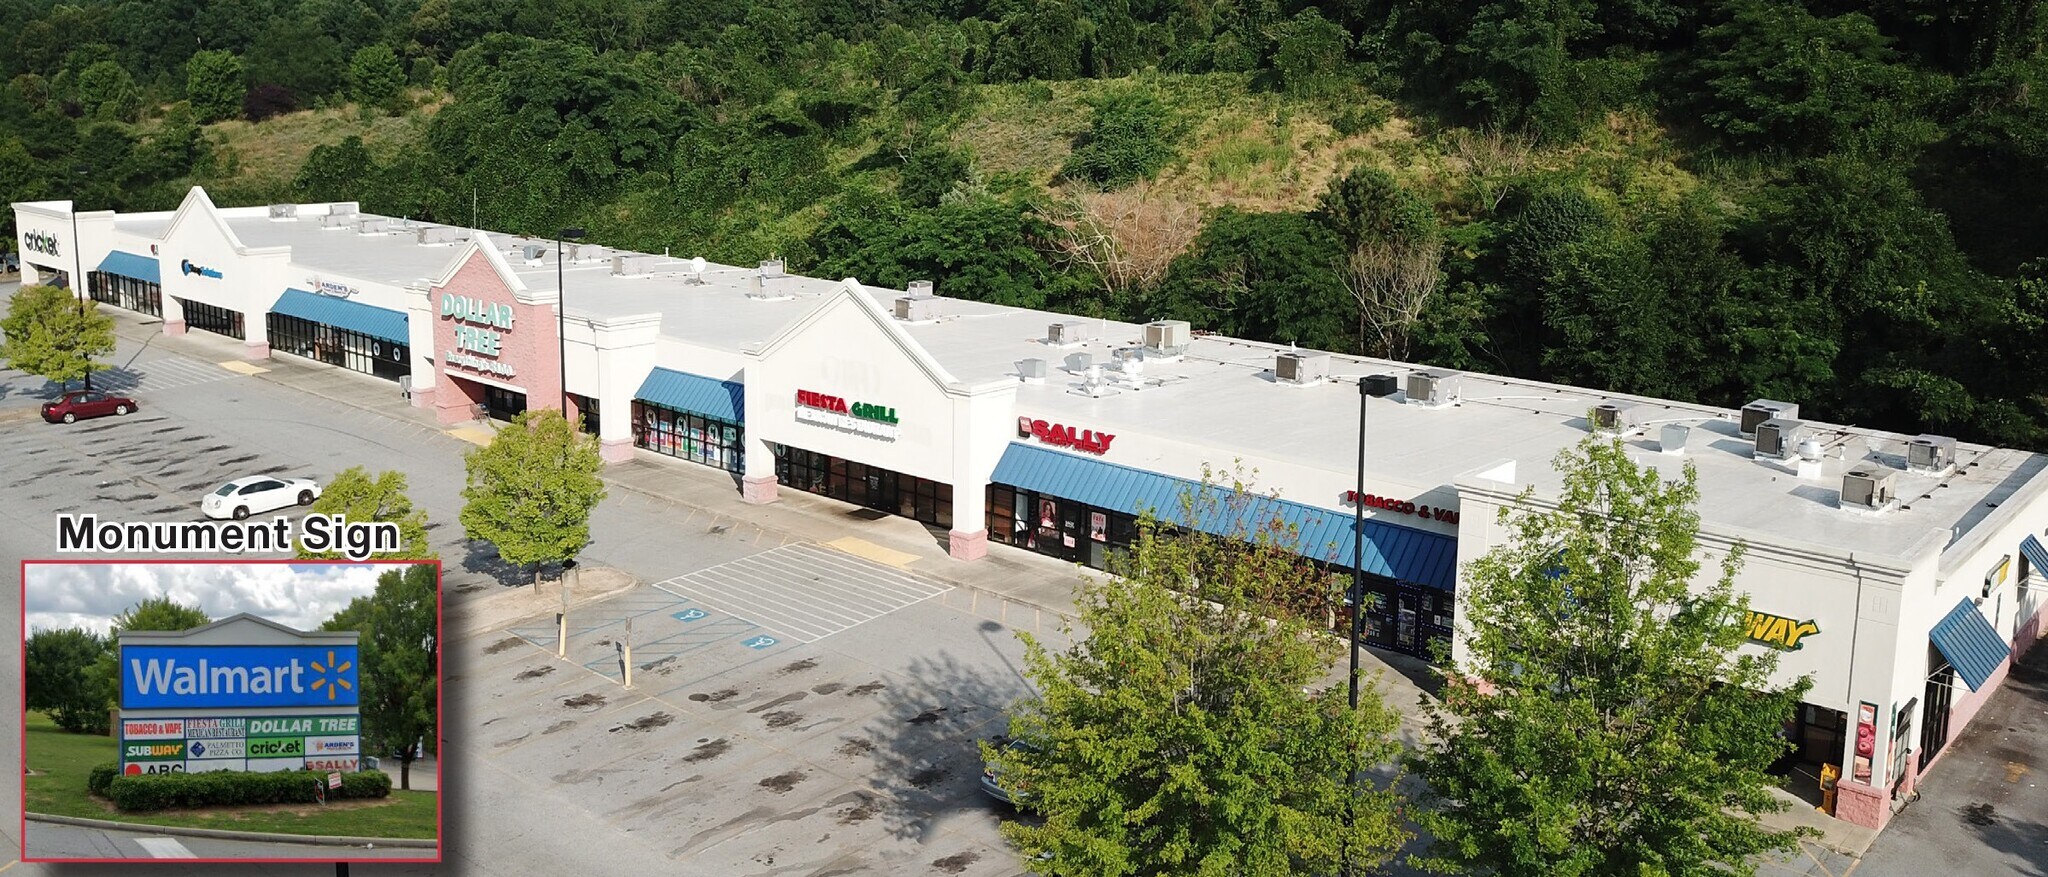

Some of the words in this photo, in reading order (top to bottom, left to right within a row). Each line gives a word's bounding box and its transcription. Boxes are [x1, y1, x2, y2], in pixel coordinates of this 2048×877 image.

[24, 228, 60, 257] cricket
[441, 293, 514, 331] DOLLAR
[454, 325, 501, 357] TREE
[797, 388, 848, 414] FIESTA
[851, 401, 899, 424] GRILL
[1032, 419, 1115, 451] SALLY
[1418, 504, 1431, 519] &
[131, 658, 304, 695] Walmart
[125, 723, 157, 735] TOBACCO
[158, 726, 164, 734] &
[165, 722, 182, 734] VAPE
[187, 718, 218, 729] FIESTA
[219, 718, 246, 728] GRILL
[250, 719, 313, 734] DOLLAR
[319, 717, 357, 732] TREE
[187, 728, 212, 738] MEXICAN
[212, 727, 246, 738] RESTAURANT
[126, 743, 183, 757] SUBWAY
[207, 741, 245, 749] PALMETTO
[209, 748, 229, 756] PIZZA
[250, 740, 301, 754] cricket
[316, 758, 358, 770] SALLY
